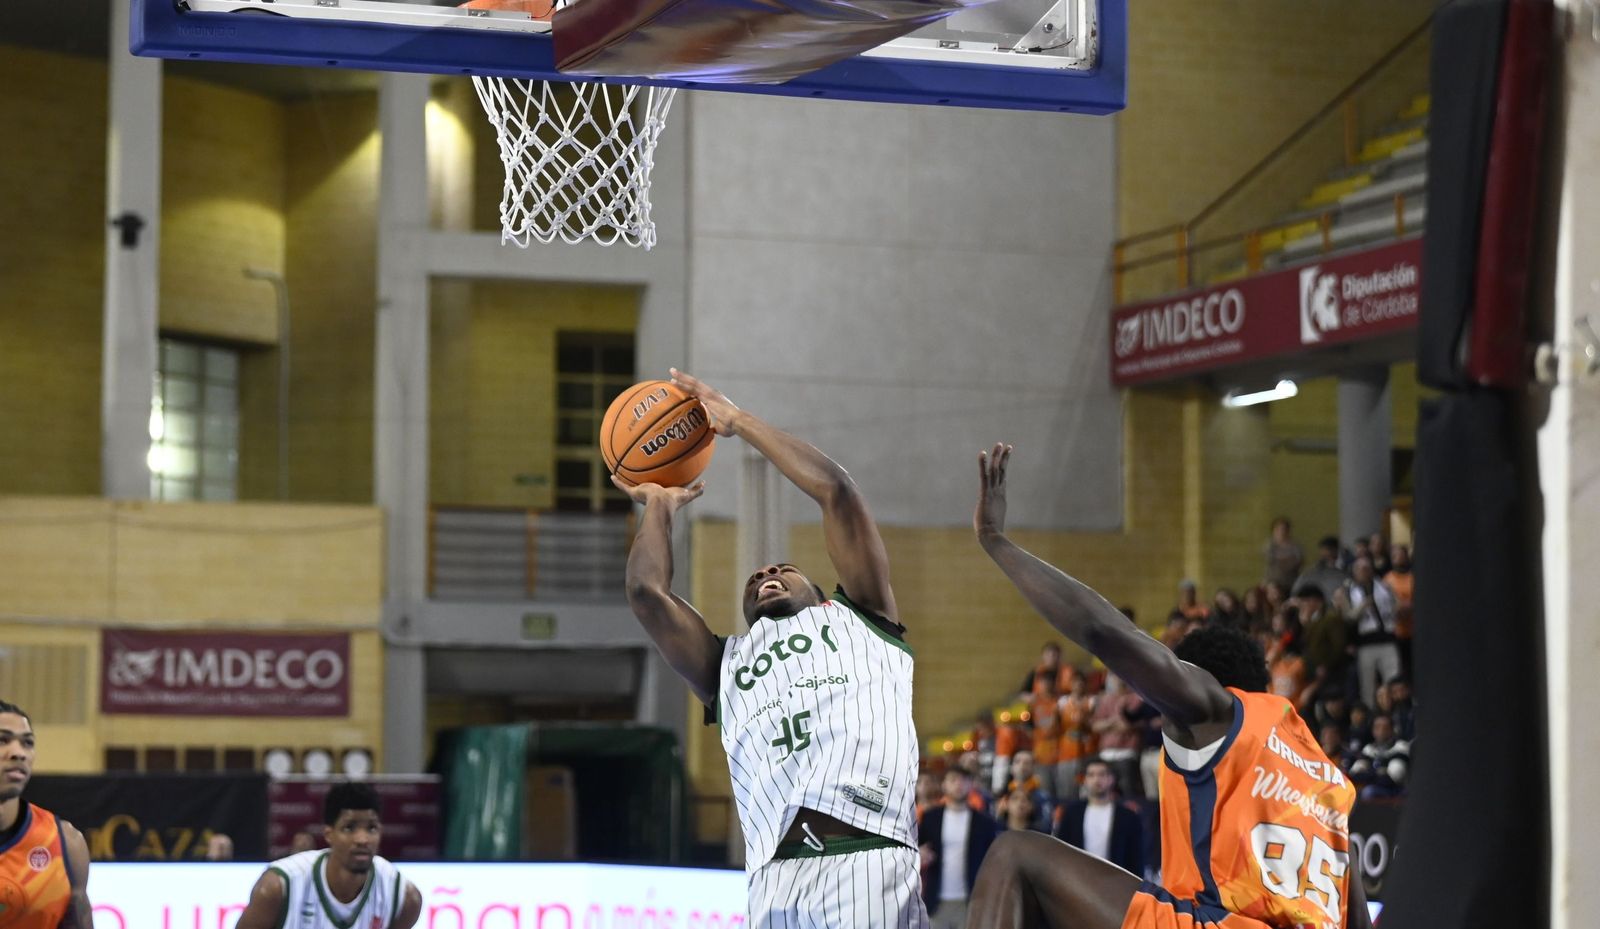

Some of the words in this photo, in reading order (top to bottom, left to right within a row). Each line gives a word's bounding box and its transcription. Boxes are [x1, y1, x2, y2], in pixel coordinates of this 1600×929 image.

[1342, 263, 1417, 301] Diputación
[1142, 288, 1244, 351] IMDECO
[1343, 302, 1360, 328] de
[1362, 292, 1417, 324] Córdoba
[640, 407, 707, 456] Wilson
[163, 648, 344, 689] IMDECO
[735, 633, 813, 691] coto
[1250, 821, 1349, 925] 85
